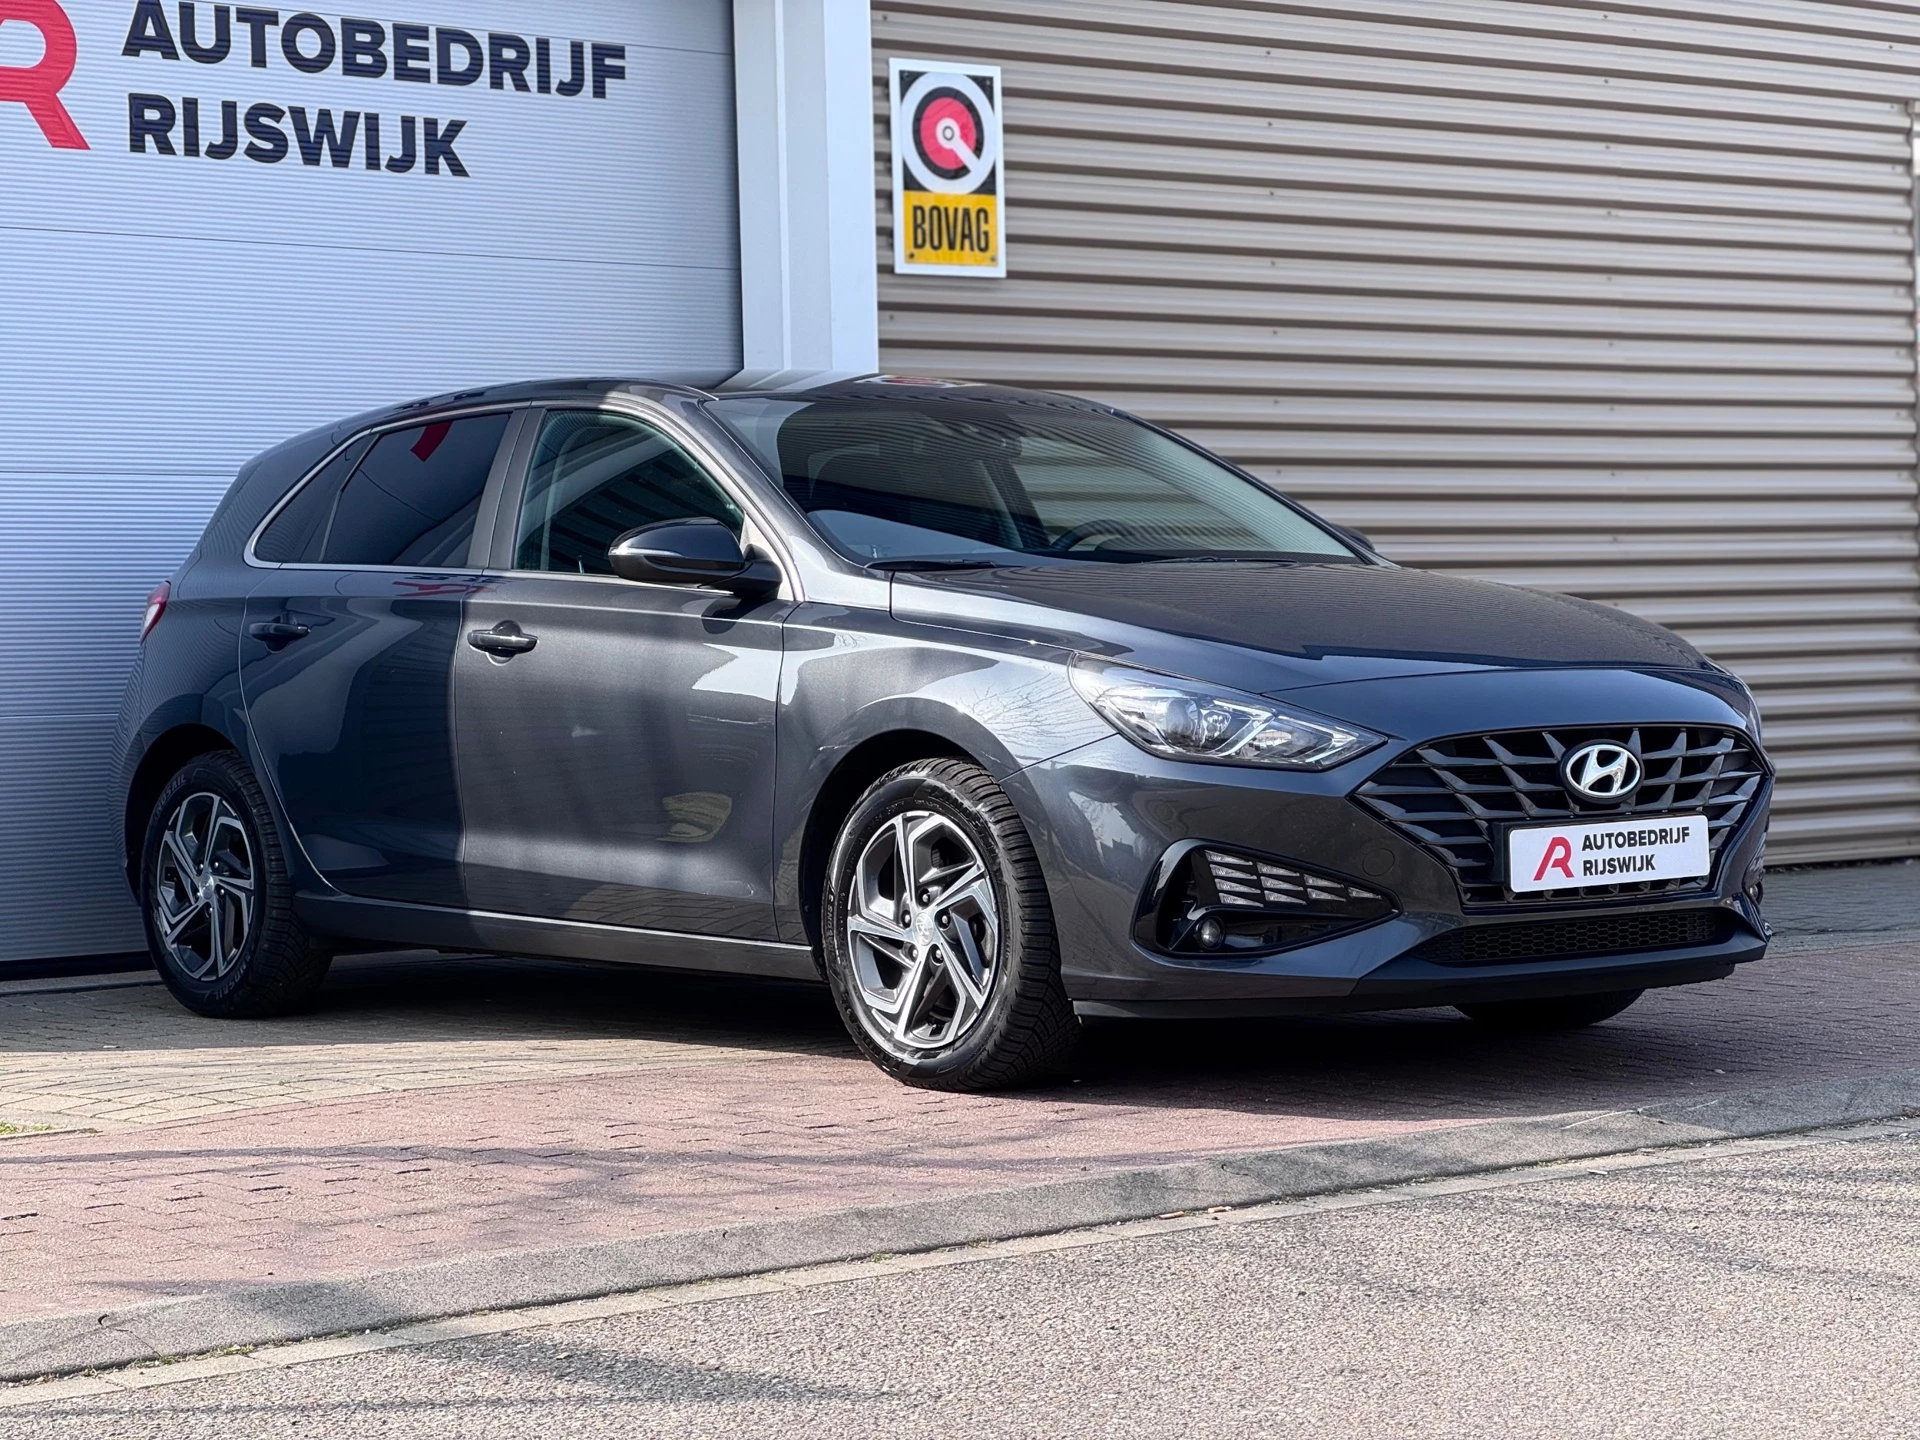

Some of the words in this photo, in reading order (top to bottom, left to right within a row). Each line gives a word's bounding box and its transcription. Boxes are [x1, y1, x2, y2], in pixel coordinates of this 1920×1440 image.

[121, 0, 626, 99] AUTOBEDRIJF
[128, 92, 470, 178] RIJSWIJK
[912, 205, 990, 253] BOVAG
[153, 774, 186, 826] NDSAIL
[1582, 826, 1690, 851] AUTOBEDRIJF
[1583, 854, 1656, 876] RIJSWIJK
